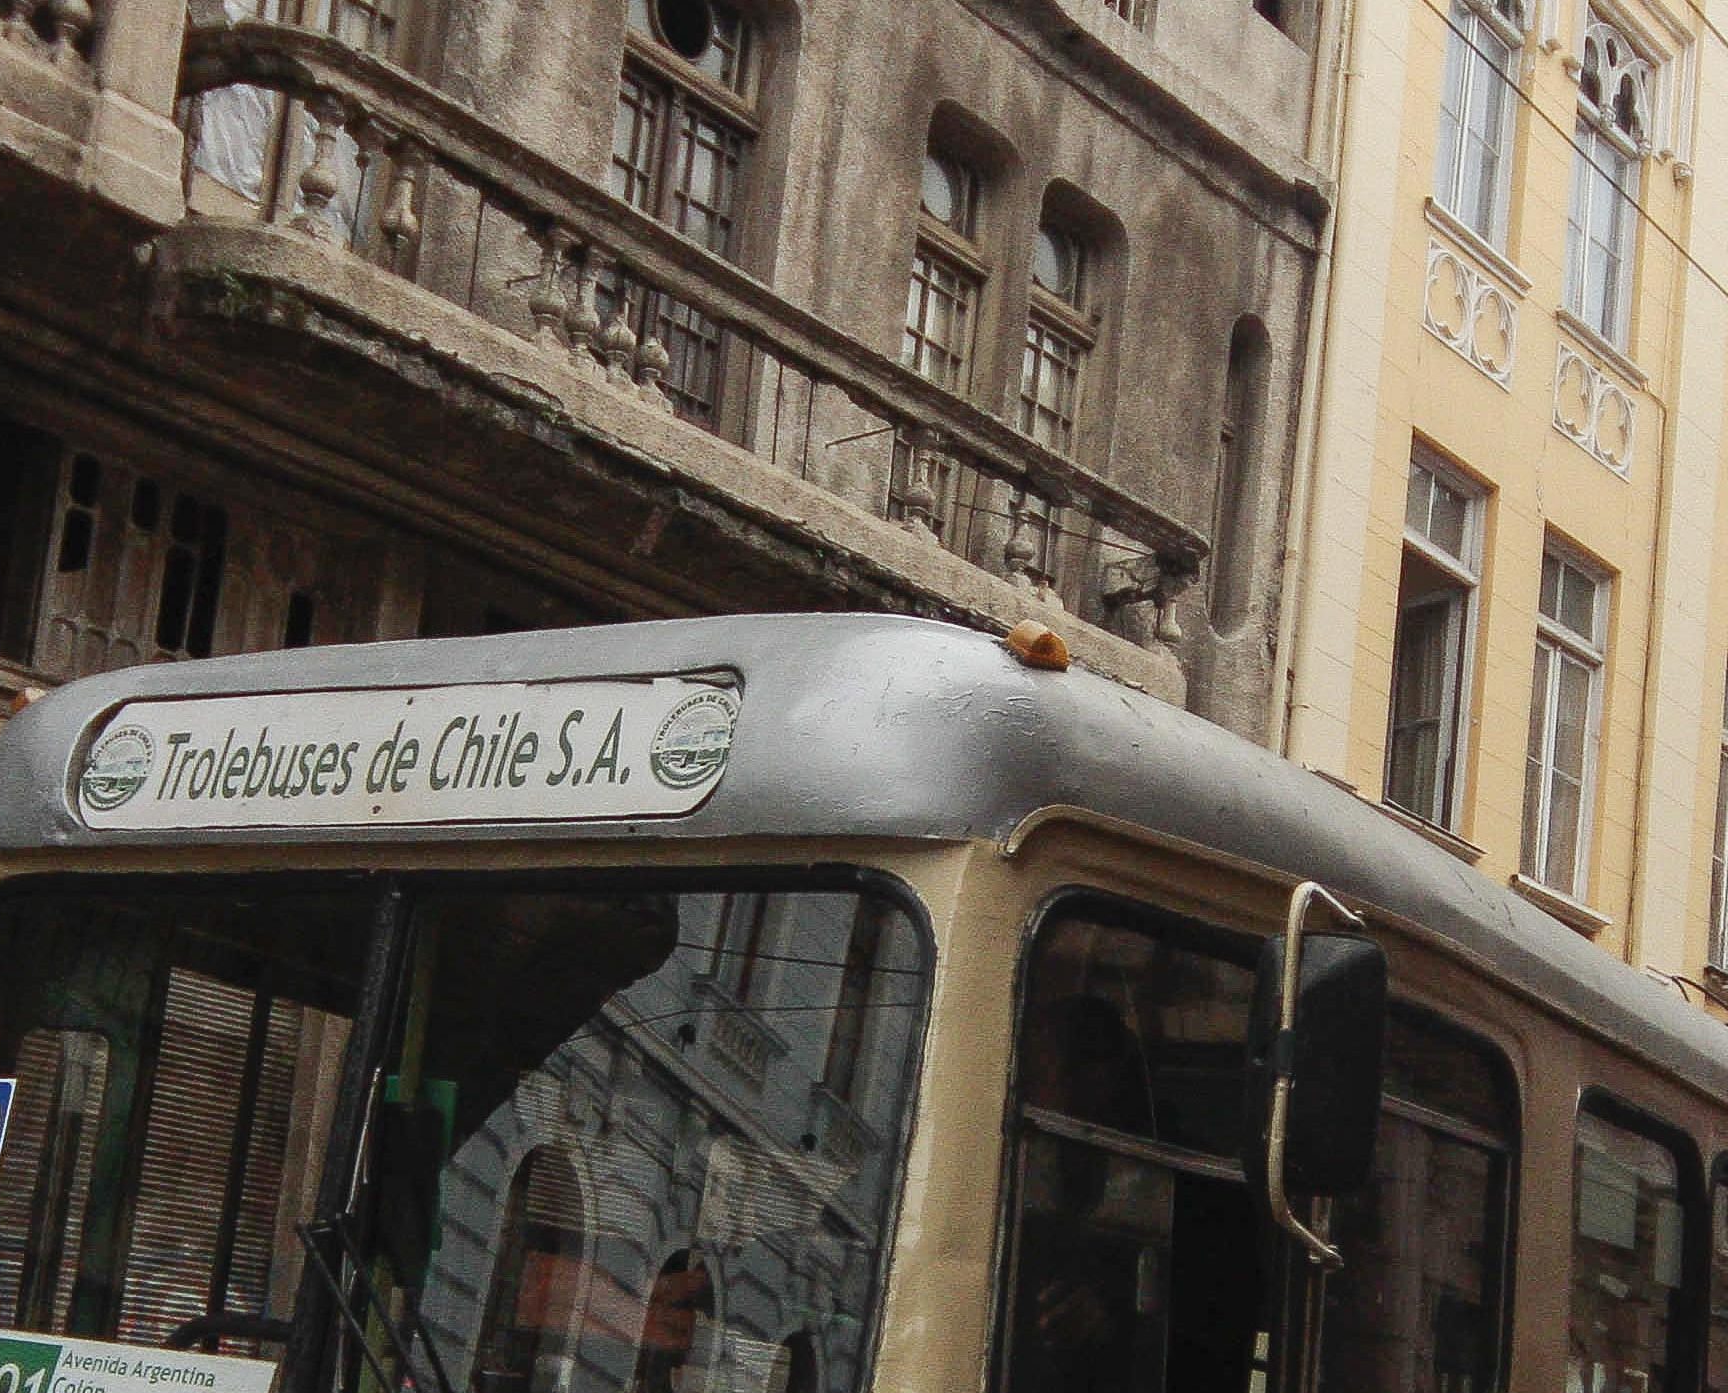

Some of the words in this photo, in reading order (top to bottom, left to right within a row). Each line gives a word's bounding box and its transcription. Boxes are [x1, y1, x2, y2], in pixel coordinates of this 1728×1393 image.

[157, 727, 360, 800] Trolebuses
[366, 720, 419, 794] de
[430, 711, 538, 791] Chile
[547, 708, 630, 786] S.A.
[61, 1351, 129, 1376] Avenida
[131, 1360, 215, 1388] Argentina
